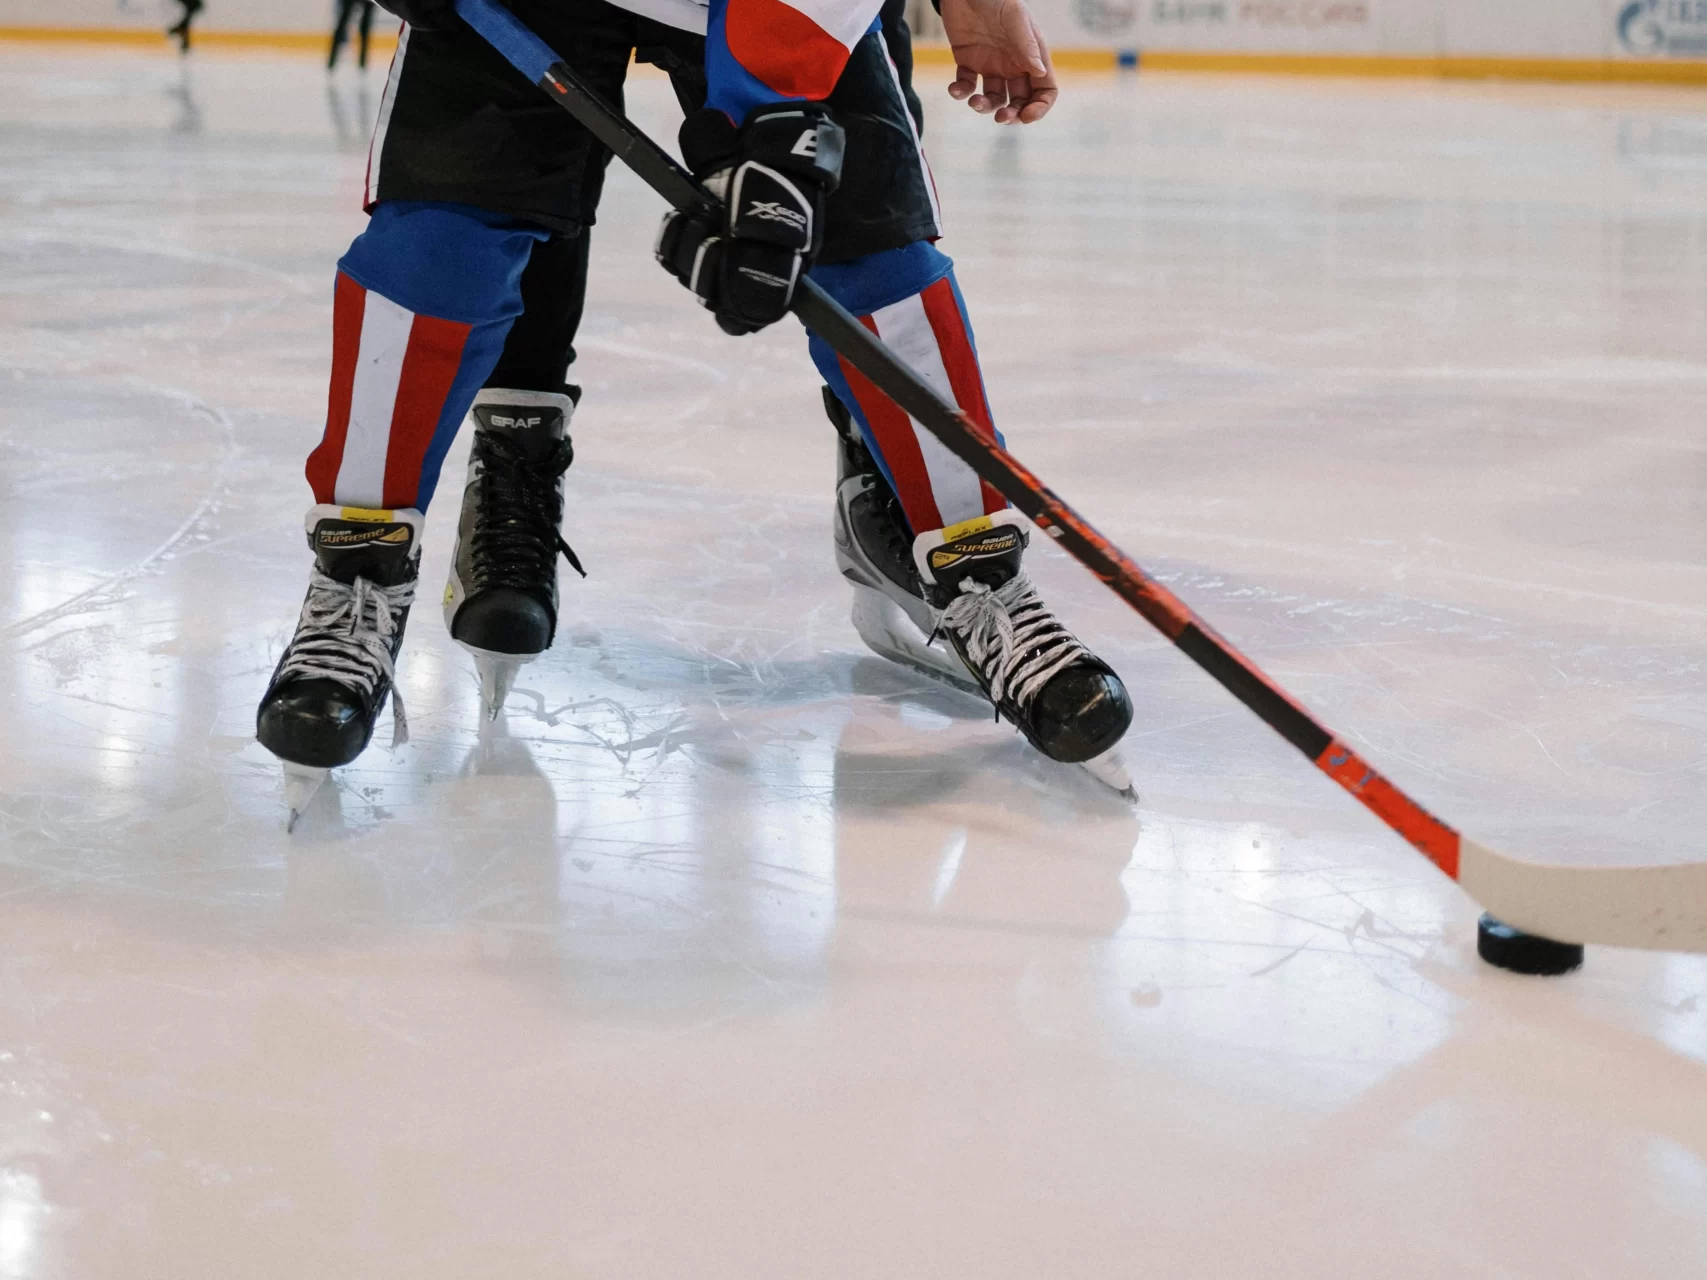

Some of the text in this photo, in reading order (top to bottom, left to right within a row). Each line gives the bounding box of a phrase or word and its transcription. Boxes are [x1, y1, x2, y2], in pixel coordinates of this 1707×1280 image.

[490, 414, 542, 429] GRAF
[320, 527, 385, 543] SUPREME
[981, 533, 1015, 545] BAUER
[951, 538, 1017, 552] SUPREME
